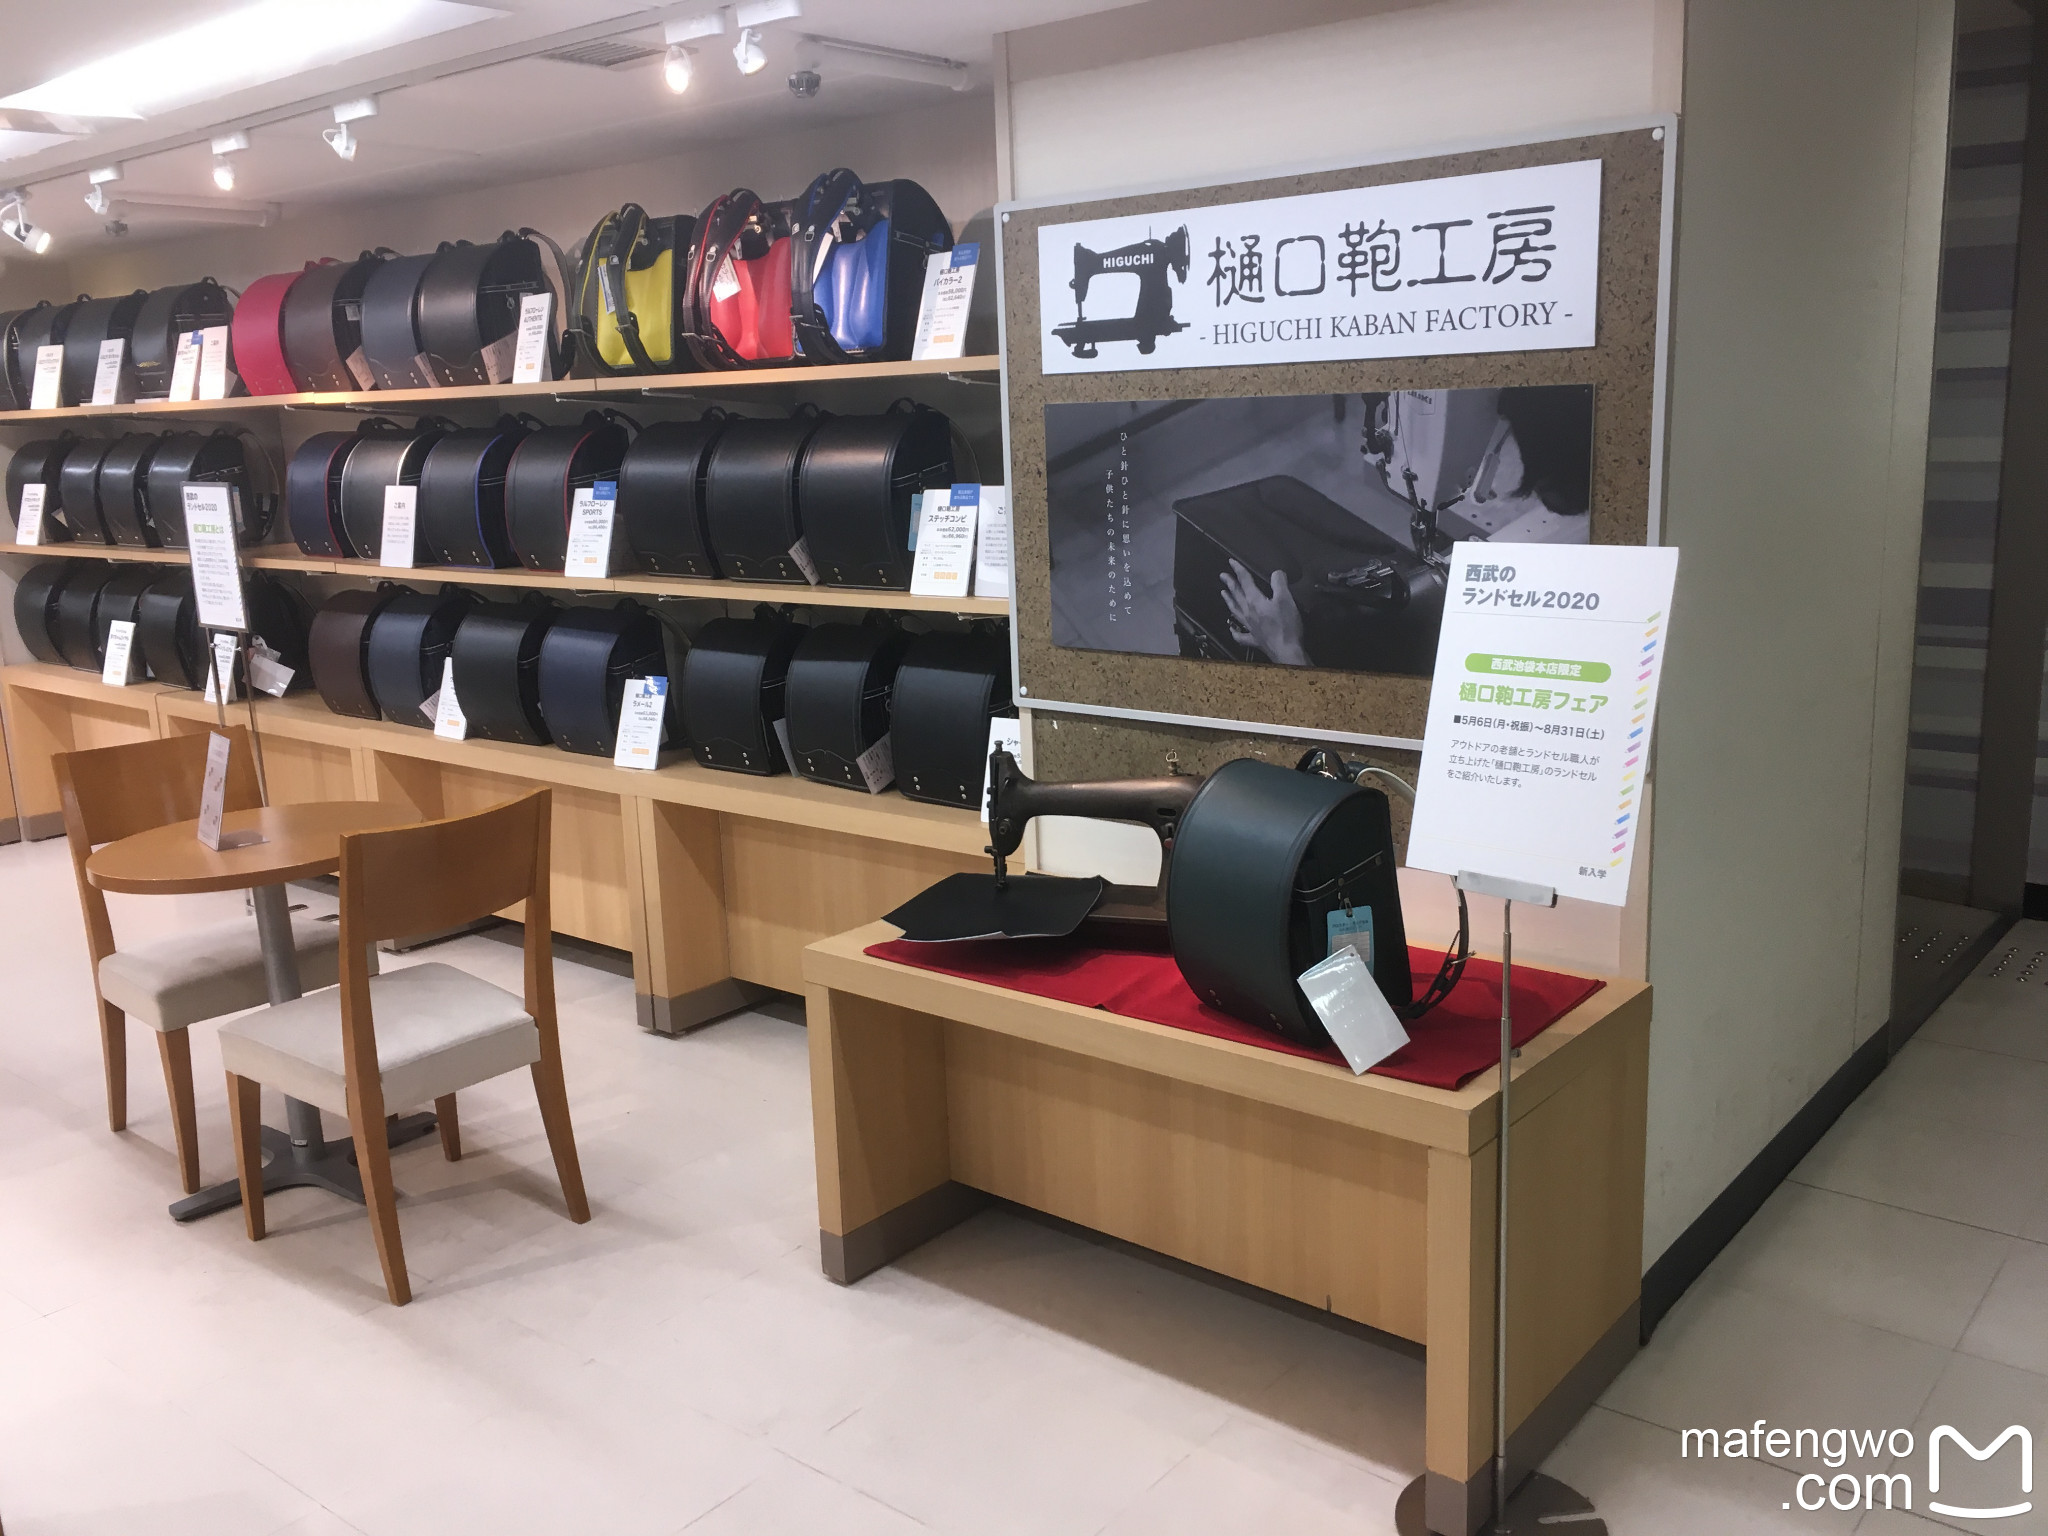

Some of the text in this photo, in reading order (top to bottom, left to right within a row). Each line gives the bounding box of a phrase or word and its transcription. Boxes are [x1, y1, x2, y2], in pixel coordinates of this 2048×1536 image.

[1101, 253, 1155, 269] HIGUCHI
[1206, 204, 1557, 308] 樋口鞄工房
[933, 275, 963, 287] バイカラー2
[1212, 317, 1322, 346] HIGUCHI
[1330, 310, 1418, 339] KABAN
[1424, 301, 1557, 333] FACTORY
[582, 508, 603, 516] SPORTS
[928, 514, 968, 523] ステッチコンビ
[1119, 431, 1133, 616] ひと針ひと針に思いを込めて
[1105, 468, 1118, 623] 子供たちの未来のために
[1464, 562, 1516, 583] 西武の
[1461, 587, 1600, 611] ランドセル2020
[1490, 657, 1582, 678] 西武池袋本店限定
[1458, 682, 1609, 714] 樋口鞄工房フェア
[1450, 738, 1600, 766] アウトドアの老舗とランドセル職人が
[1446, 769, 1523, 789] をご紹介いたします。
[1448, 753, 1598, 783] 立ち上げた「樋口鞄工房」のランドセル
[1577, 865, 1608, 880] 新入学
